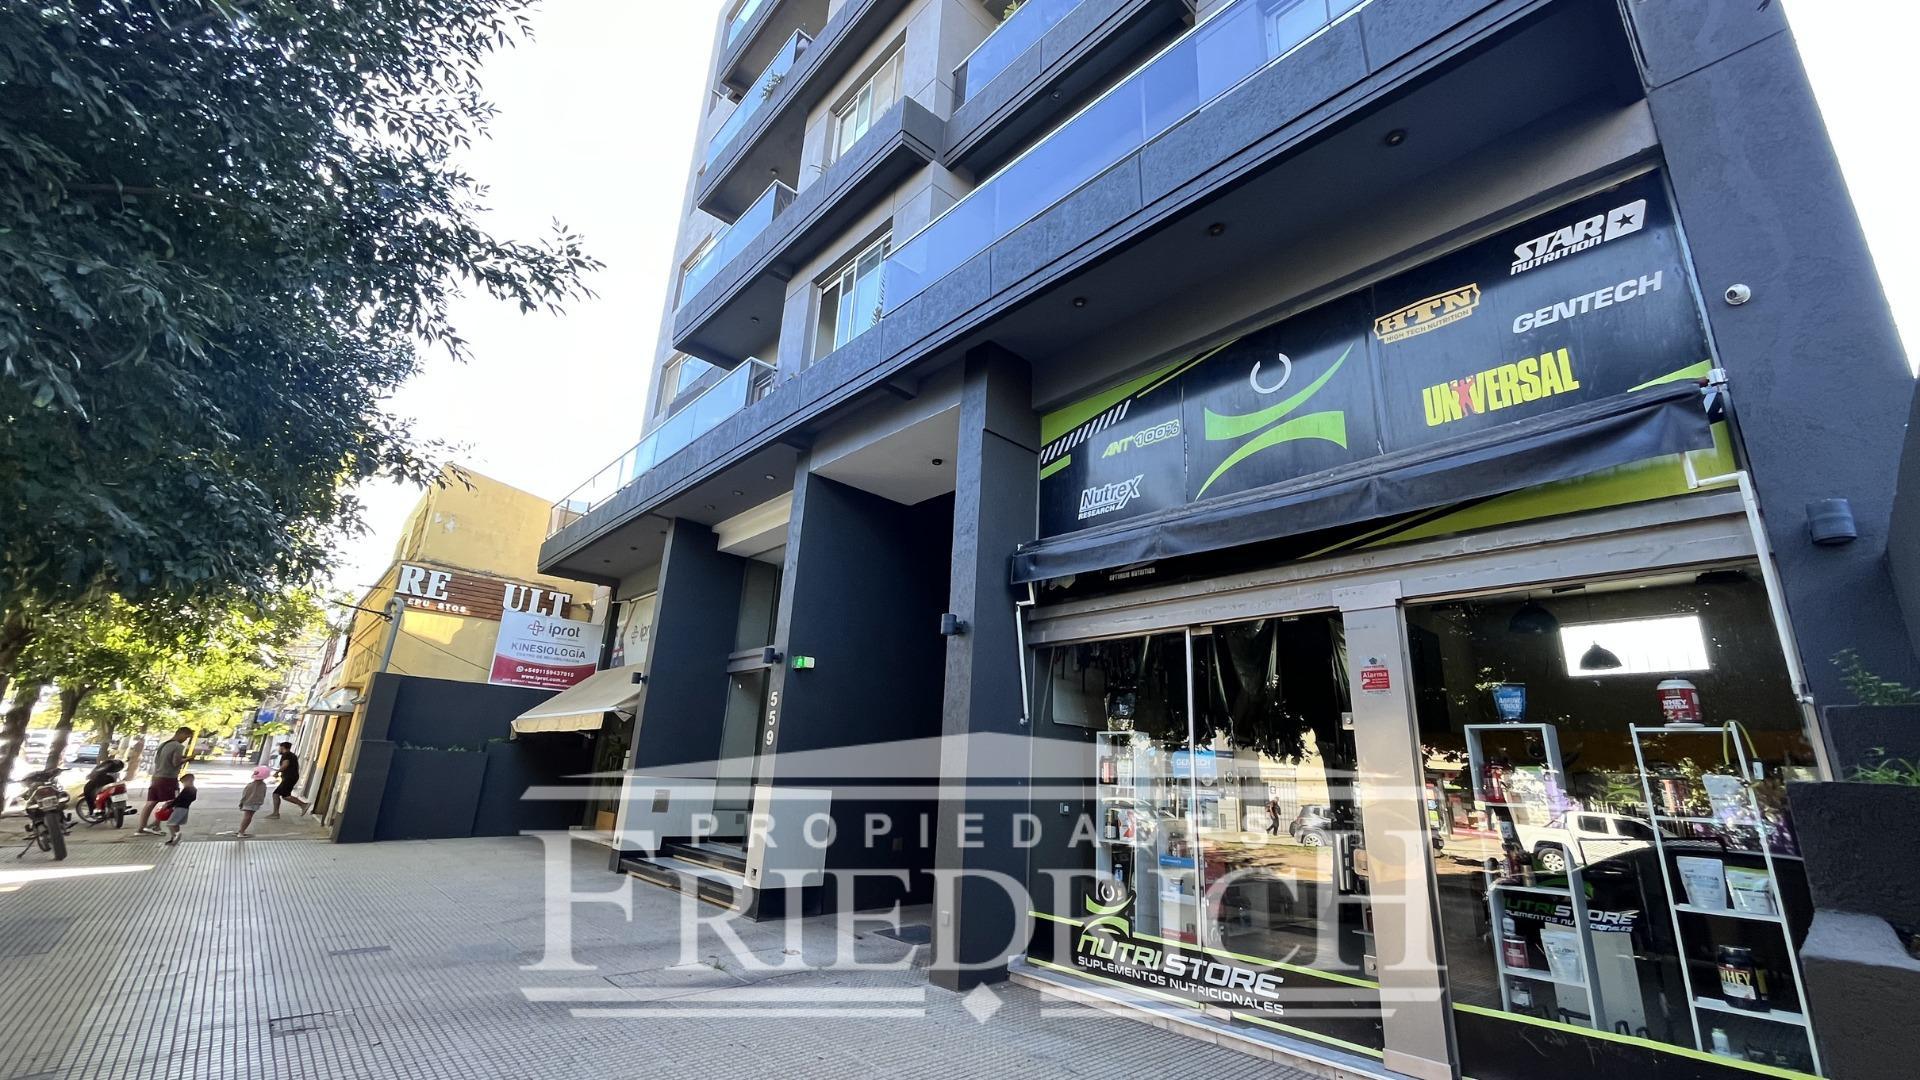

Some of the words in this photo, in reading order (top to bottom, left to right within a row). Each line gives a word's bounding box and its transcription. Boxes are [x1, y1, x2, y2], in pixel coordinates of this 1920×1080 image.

[1512, 214, 1605, 266] STAR
[1379, 288, 1474, 335] HTN
[1512, 270, 1663, 334] GENTECH
[1386, 332, 1404, 342] HIGH
[1406, 327, 1426, 337] TECH
[1427, 310, 1469, 330] NUTRITION
[1135, 419, 1181, 448] 100%
[1078, 504, 1116, 520] RESEARCH
[395, 564, 453, 601] RE
[502, 583, 570, 619] ULT
[548, 622, 581, 638] iprot
[1555, 905, 1640, 925] SORE
[1078, 956, 1166, 986] SUPLEMENTOS
[1169, 978, 1284, 1015] NUTRICIONALES
